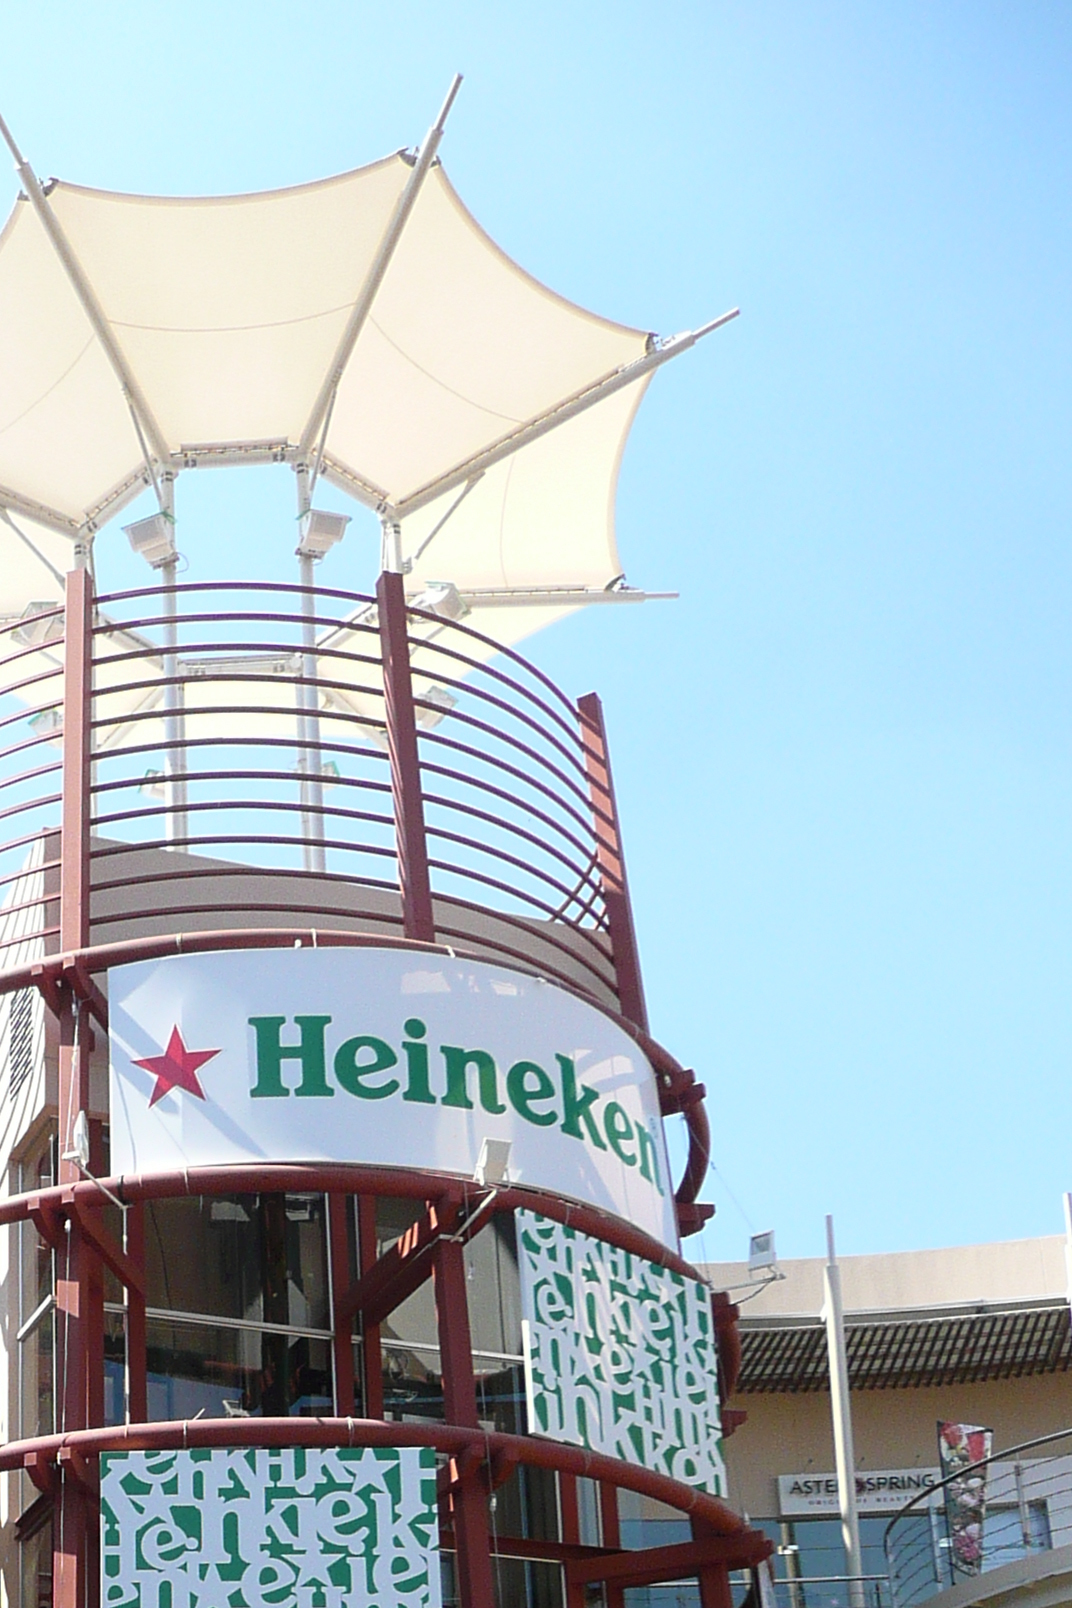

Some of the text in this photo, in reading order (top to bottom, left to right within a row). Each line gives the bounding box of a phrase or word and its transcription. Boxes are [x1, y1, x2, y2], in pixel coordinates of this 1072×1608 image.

[247, 1014, 665, 1197] Heineken
[789, 1473, 935, 1495] ASTE SPRING
